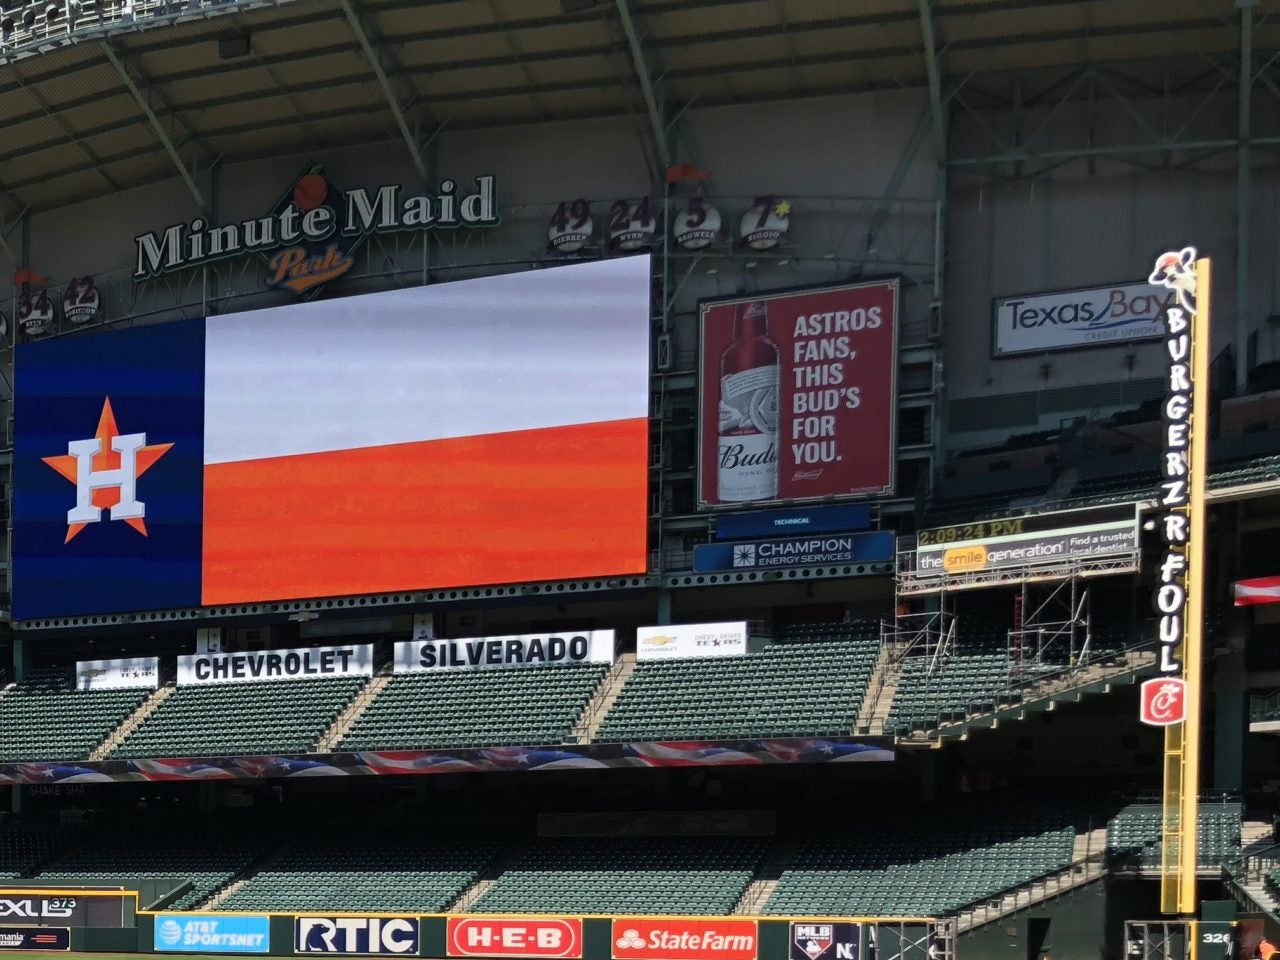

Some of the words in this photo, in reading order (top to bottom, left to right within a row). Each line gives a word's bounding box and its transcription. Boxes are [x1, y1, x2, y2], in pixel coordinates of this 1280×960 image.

[548, 198, 591, 233] 49
[609, 196, 653, 231] 24
[685, 197, 708, 229] 5
[751, 193, 778, 229] 7
[134, 199, 335, 277] Minute
[343, 175, 497, 232] Maid
[267, 243, 346, 286] Park
[793, 306, 882, 337] ASTROS
[1006, 301, 1095, 330] Texas
[1108, 289, 1175, 324] Bay
[1084, 330, 1119, 341] CREDIT
[1121, 326, 1157, 337] UNION
[793, 336, 856, 363] FANS,
[793, 362, 844, 388] THIS
[793, 386, 861, 414] BUD'S
[792, 415, 835, 440] FOR
[791, 441, 842, 465] YOU.
[773, 517, 810, 526] TECHNICAL
[919, 523, 985, 546] 2:09:24
[990, 519, 1023, 538] PM
[758, 538, 852, 557] CHAMPION
[1070, 536, 1091, 546] Find
[1099, 530, 1135, 542] trusted
[758, 556, 799, 566] ENERGY
[800, 552, 852, 563] SERVICES
[920, 555, 943, 569] the
[947, 549, 983, 566] smile
[987, 541, 1063, 563] generation
[1157, 553, 1185, 672] FOUL
[195, 649, 354, 680] CHEVROLET
[419, 635, 589, 668] SILVERADO
[50, 897, 77, 909] 373
[183, 920, 218, 934] AT&T
[183, 933, 265, 947] SPORTSNET
[299, 917, 415, 953] RTIC
[467, 926, 562, 949] H-E-B
[796, 926, 831, 937] MLB
